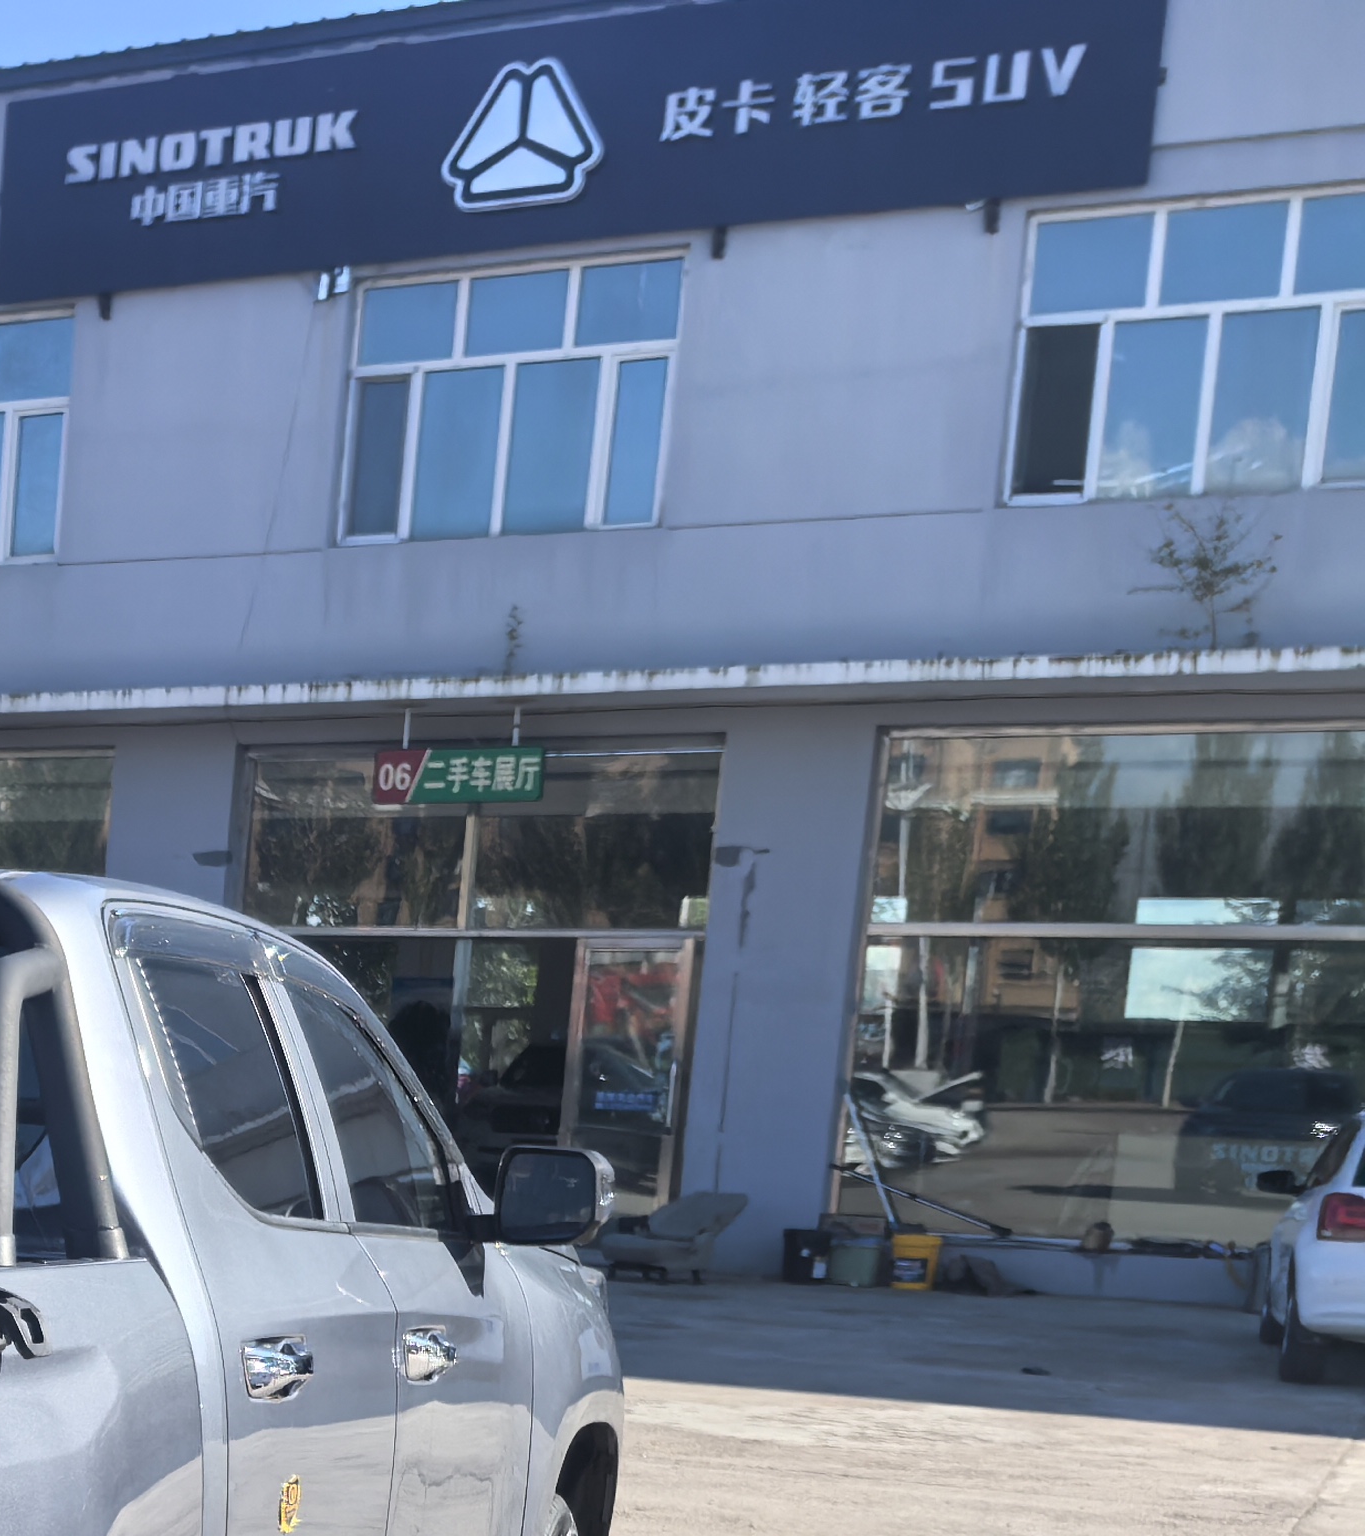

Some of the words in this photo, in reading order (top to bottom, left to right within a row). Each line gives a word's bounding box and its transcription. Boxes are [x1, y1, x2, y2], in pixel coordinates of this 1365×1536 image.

[659, 86, 776, 142] 皮卡
[791, 63, 913, 128] 轻客
[929, 43, 1087, 110] SUV
[64, 109, 359, 185] SINOTRUK
[130, 171, 281, 226] 中国重汽
[378, 762, 412, 791] 06
[423, 755, 541, 793] 二手车展厅
